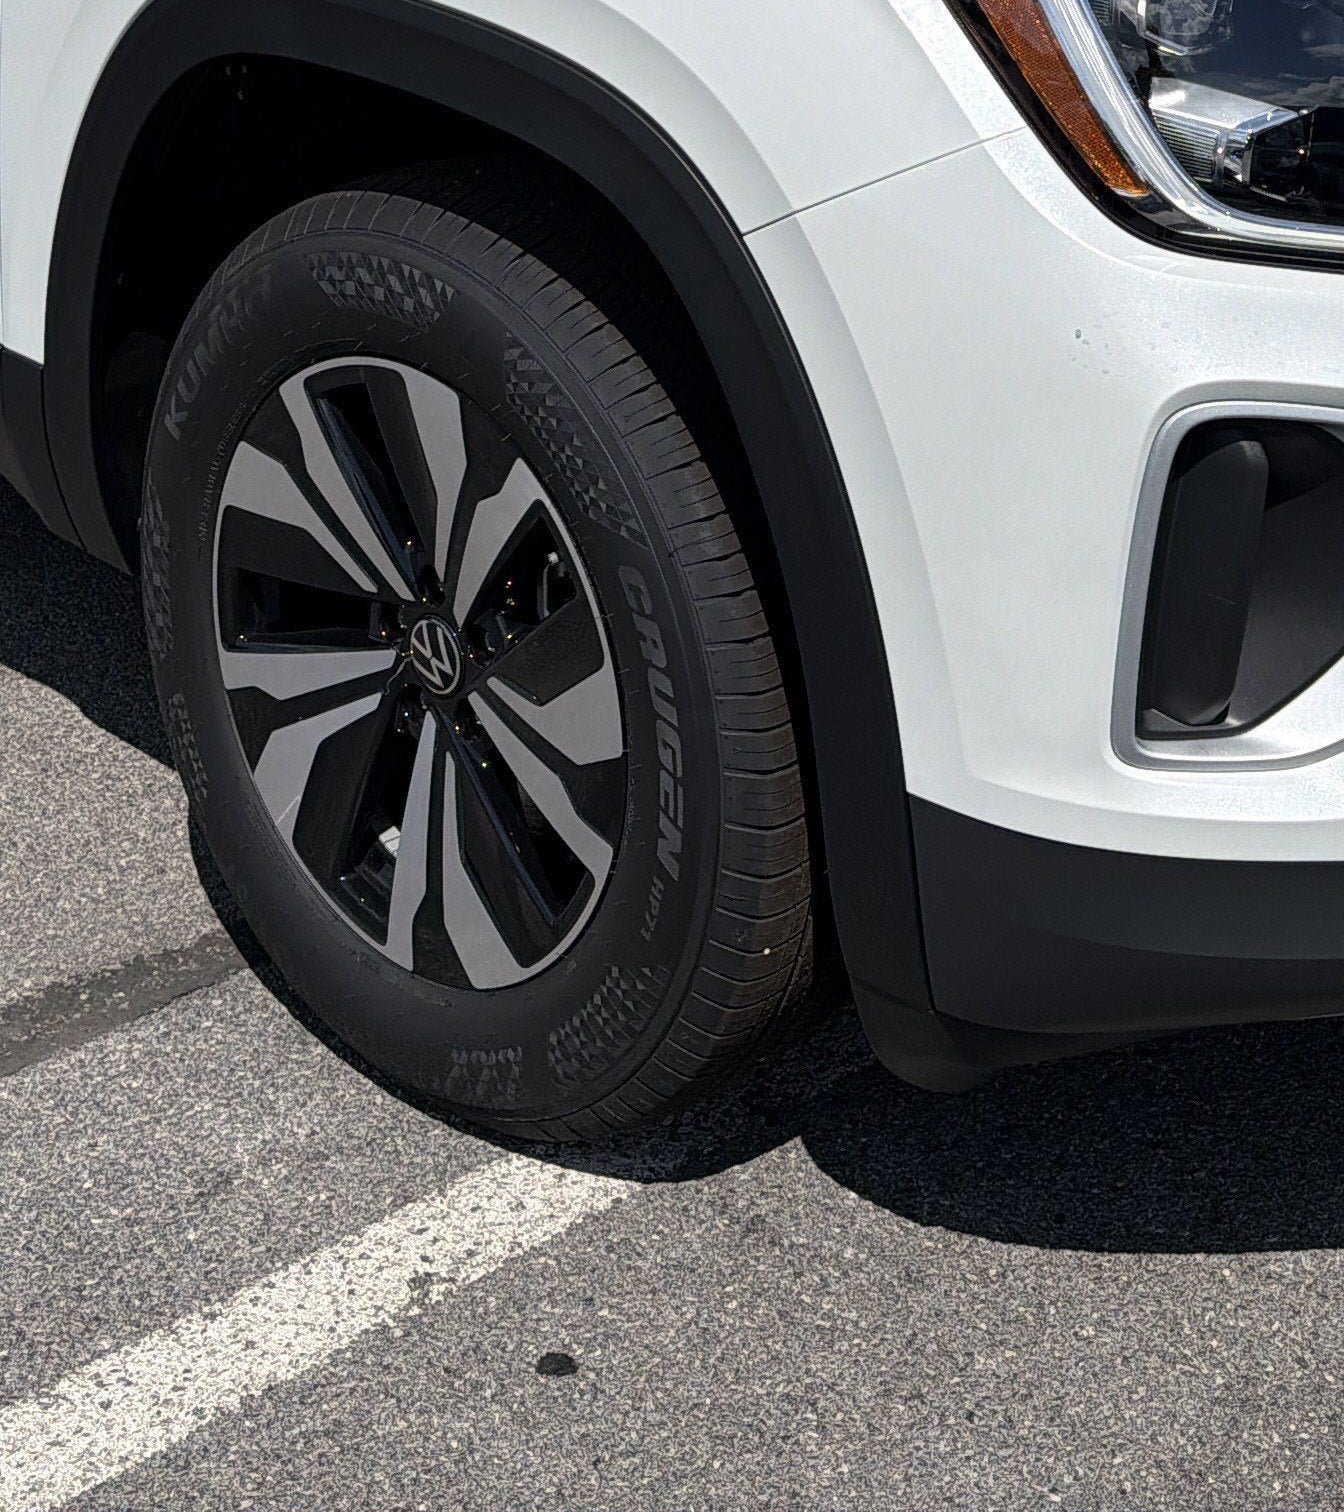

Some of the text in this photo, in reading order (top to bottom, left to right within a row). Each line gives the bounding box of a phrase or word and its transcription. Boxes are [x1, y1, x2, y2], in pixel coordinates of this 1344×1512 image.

[163, 263, 274, 442] KUMHO
[617, 563, 685, 883] CRUGEN
[640, 876, 666, 944] HP71
